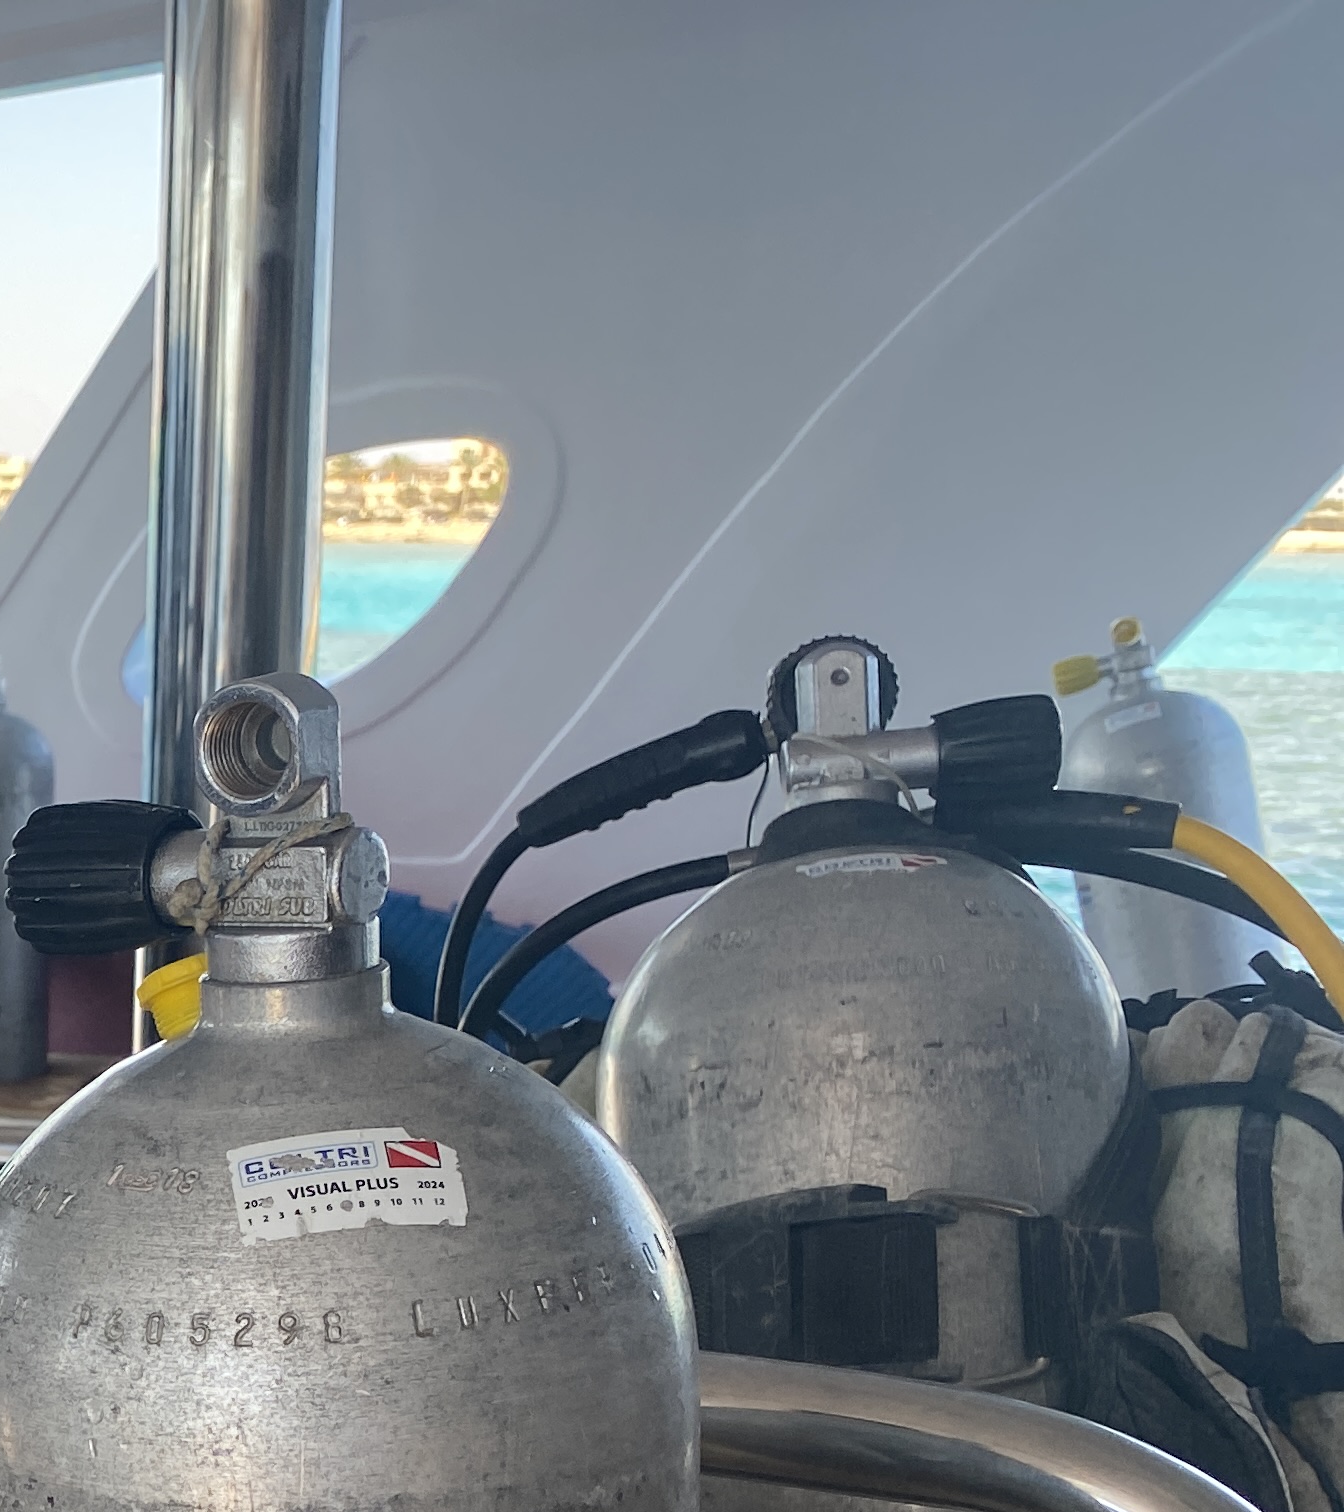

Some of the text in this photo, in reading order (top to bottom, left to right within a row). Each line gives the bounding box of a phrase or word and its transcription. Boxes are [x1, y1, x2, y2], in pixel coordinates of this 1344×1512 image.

[219, 897, 315, 916] OLTRI SUB
[244, 1177, 445, 1210] 202 VISUAL PLUS 2024
